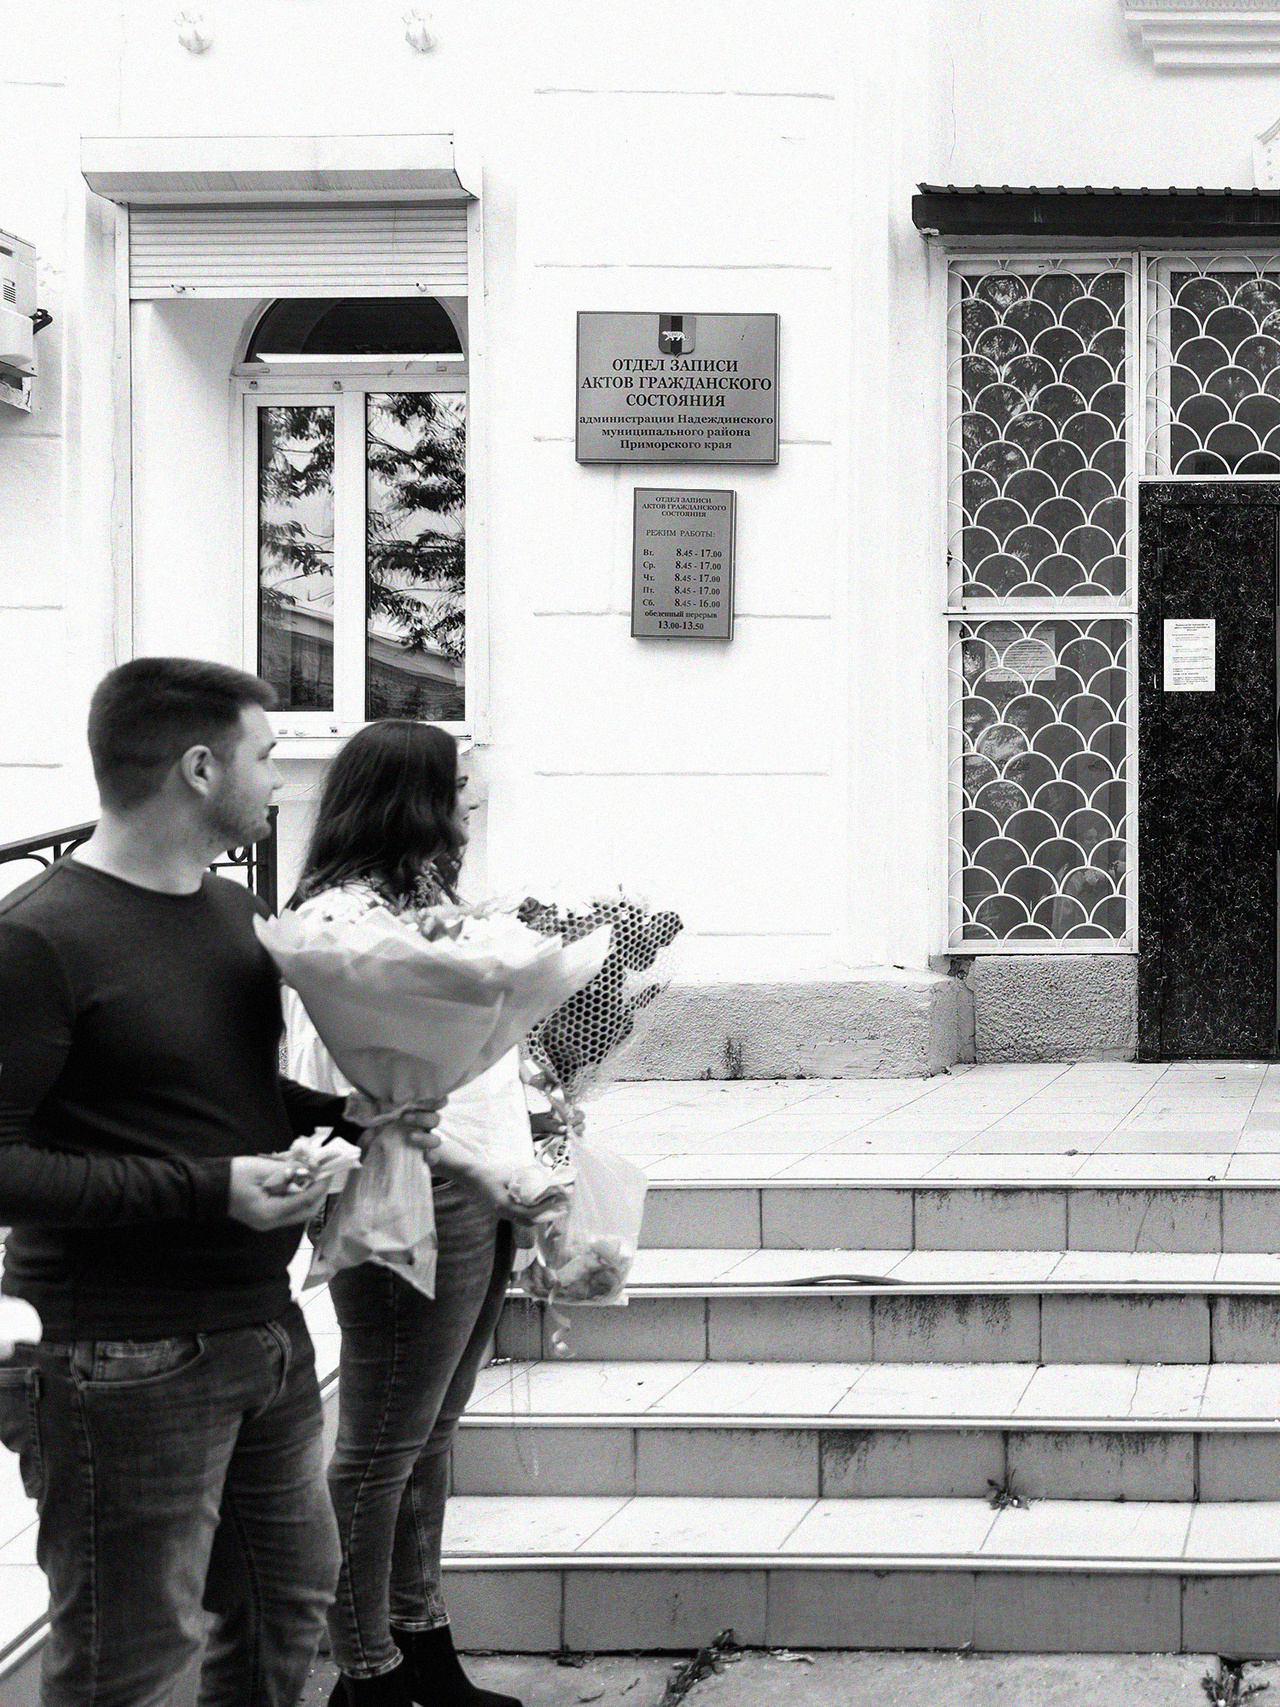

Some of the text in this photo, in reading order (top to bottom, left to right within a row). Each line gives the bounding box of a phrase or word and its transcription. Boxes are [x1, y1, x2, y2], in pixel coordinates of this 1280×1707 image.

[612, 359, 738, 372] ОТДЕЛ ЗАПИСИ
[581, 377, 771, 390] АКТОВ ГРАЖДАНСКОГО
[626, 394, 725, 407] СОСТОЯНИЯ
[580, 415, 774, 425] администрации Надеждинского
[602, 427, 750, 437] муниципального района
[620, 440, 732, 450] Приморского края
[676, 548, 692, 556] 8.45
[701, 549, 722, 557] 17.00
[643, 562, 655, 570] Ср.
[675, 561, 692, 569] 8.45
[700, 562, 721, 570] 17.00
[674, 573, 691, 581] 8.45
[700, 574, 720, 582] 17.00
[674, 586, 691, 594] 8.45
[699, 587, 720, 595] 17.00
[674, 598, 691, 606] 8.45
[700, 599, 720, 608] 16.00
[659, 621, 704, 630] 13.00-13.50
